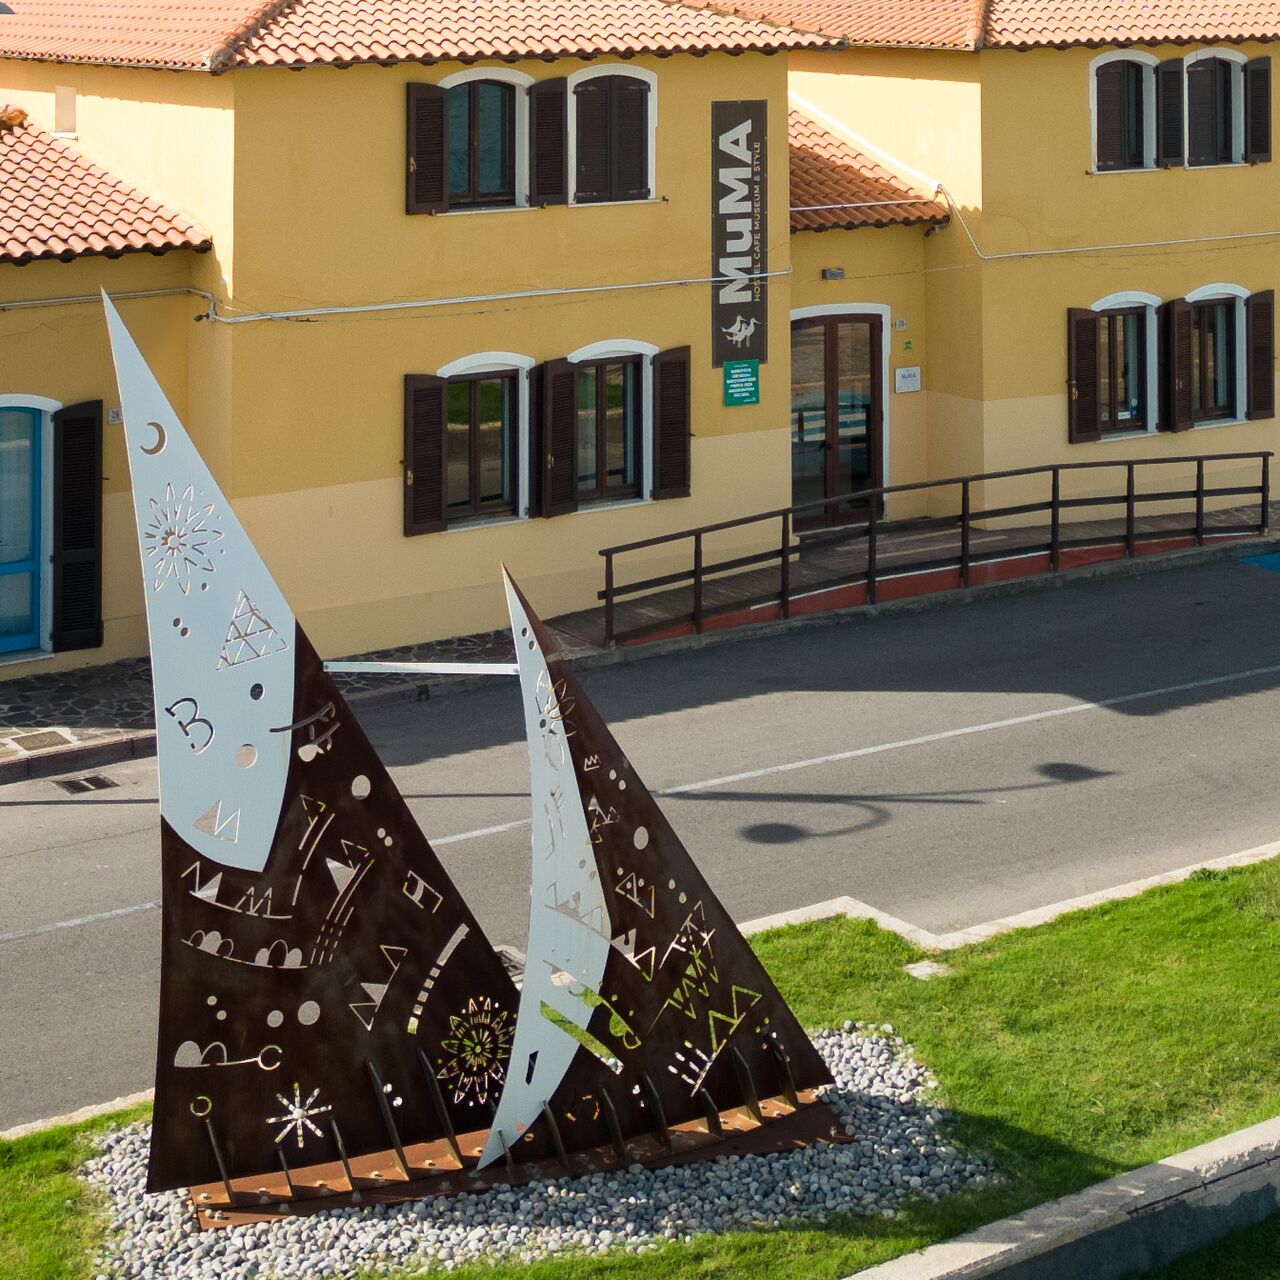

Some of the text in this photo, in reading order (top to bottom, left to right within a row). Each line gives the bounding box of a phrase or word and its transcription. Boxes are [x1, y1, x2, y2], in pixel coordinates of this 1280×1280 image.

[753, 141, 761, 172] STYLE
[719, 119, 752, 304] MuMA
[753, 185, 761, 230] MUSEUM
[753, 232, 761, 260] CAFE
